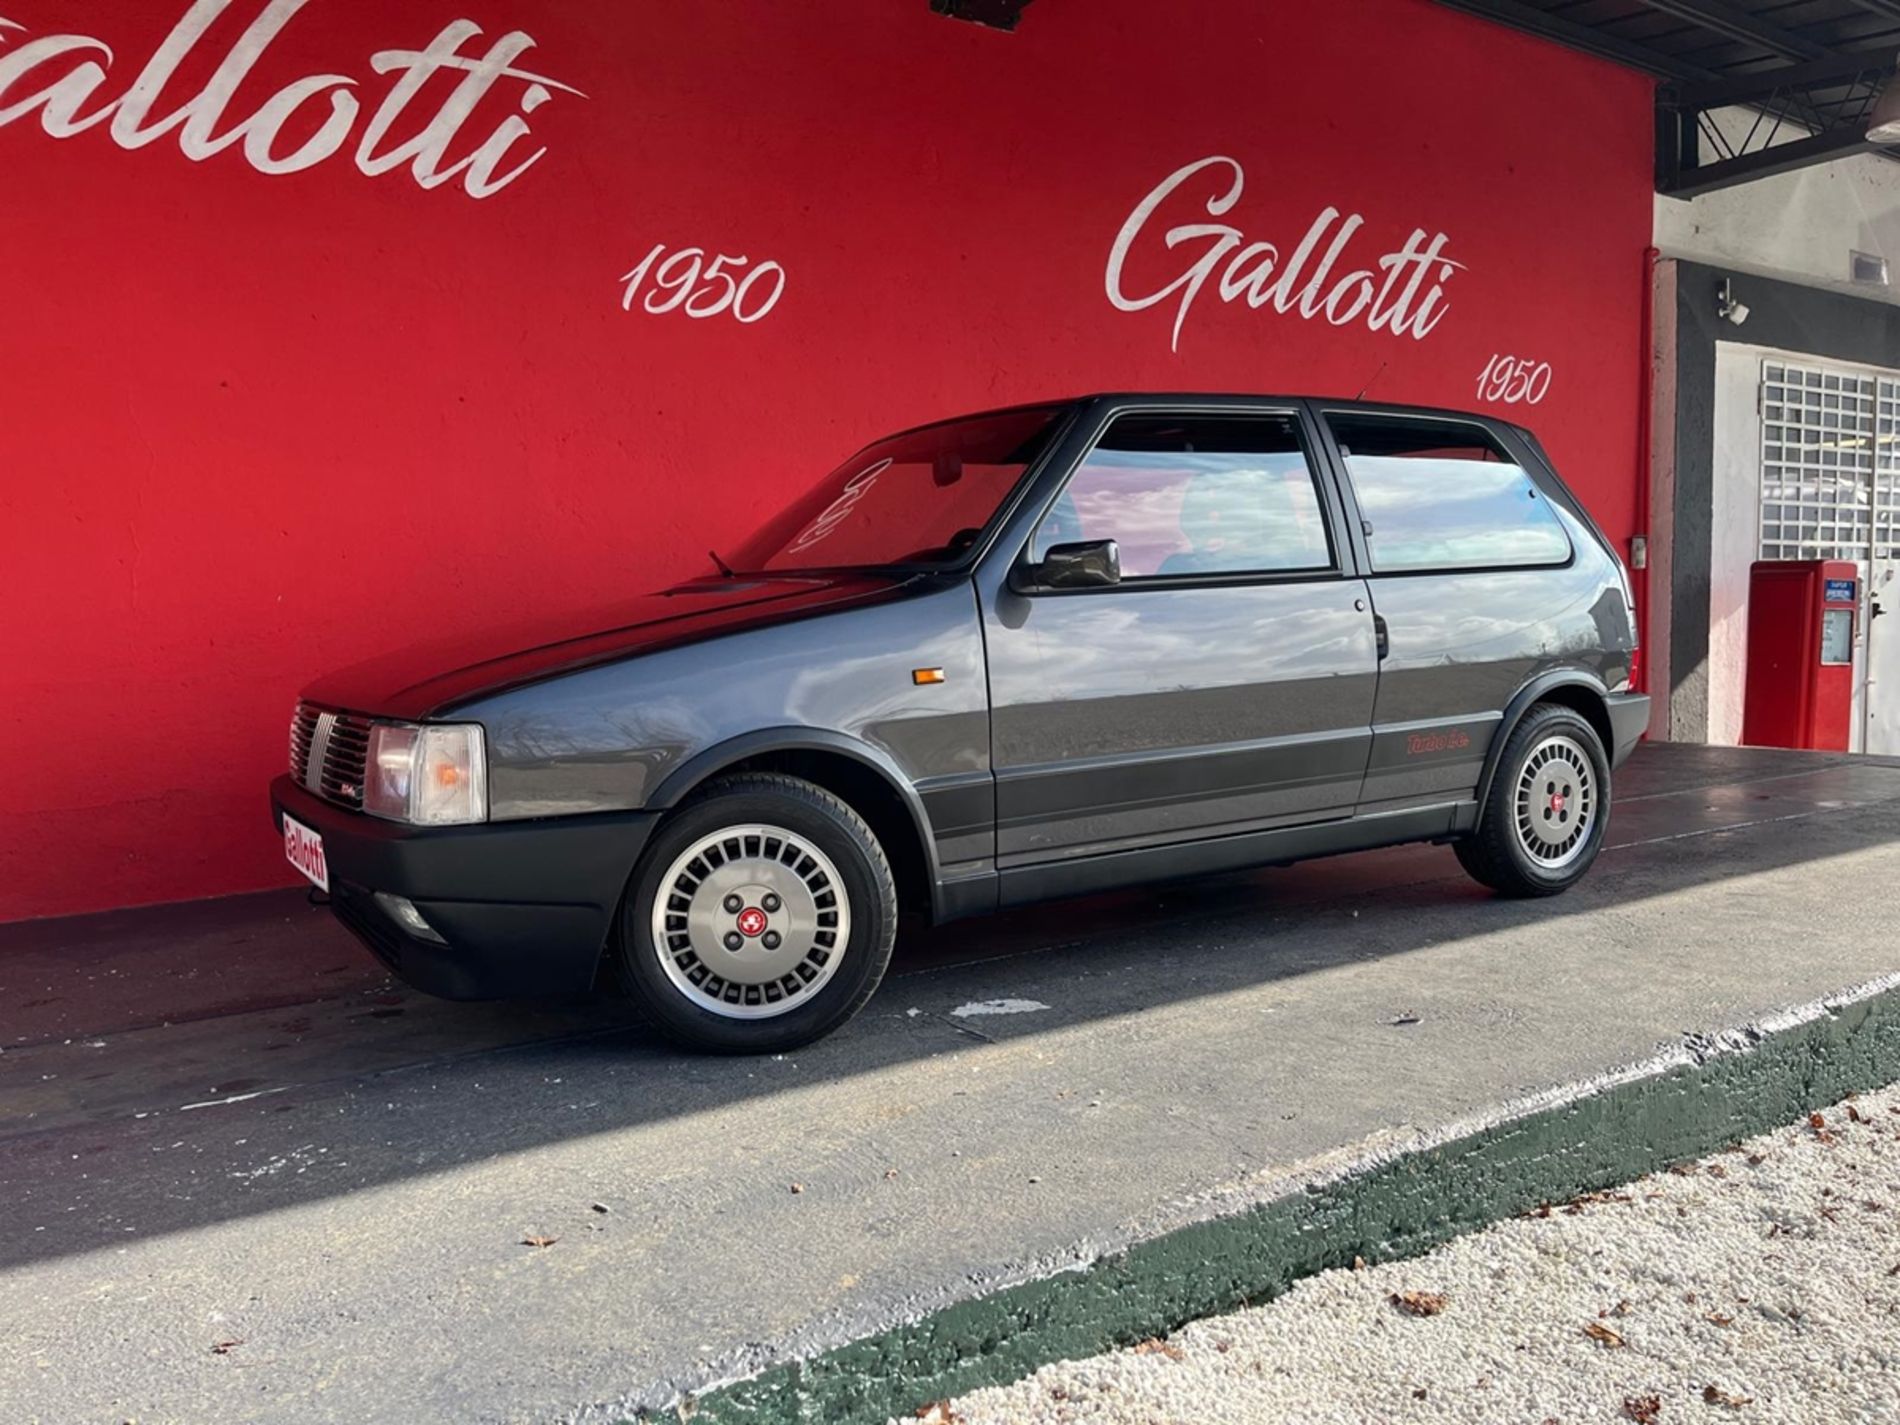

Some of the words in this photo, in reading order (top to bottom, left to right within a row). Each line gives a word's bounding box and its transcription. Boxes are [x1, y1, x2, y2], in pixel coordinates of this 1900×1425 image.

[0, 0, 590, 199] allotti
[620, 244, 785, 323] 1950
[1105, 155, 1469, 353] Gallotti
[1476, 353, 1552, 405] 1950
